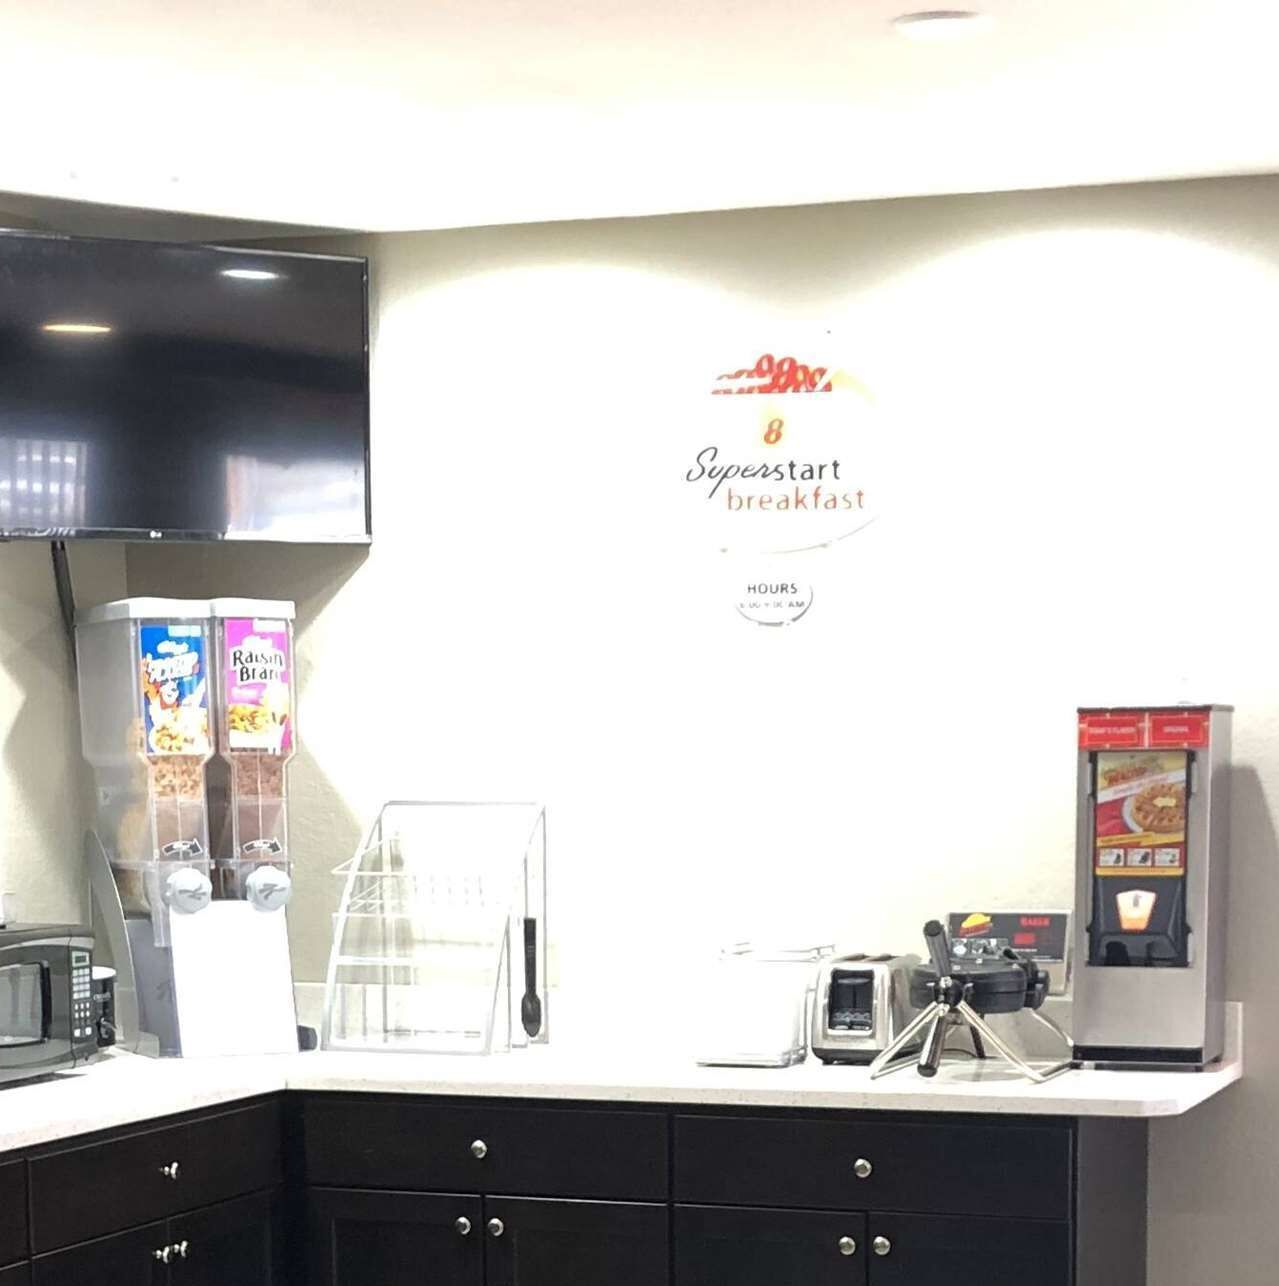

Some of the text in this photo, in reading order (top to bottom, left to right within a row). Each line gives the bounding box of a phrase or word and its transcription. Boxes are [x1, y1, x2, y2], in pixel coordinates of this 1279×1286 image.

[685, 446, 841, 500] Superstart
[727, 486, 865, 511] breakfast
[747, 583, 798, 595] HOURS
[233, 649, 284, 667] Raisin
[240, 665, 279, 682] Bran
